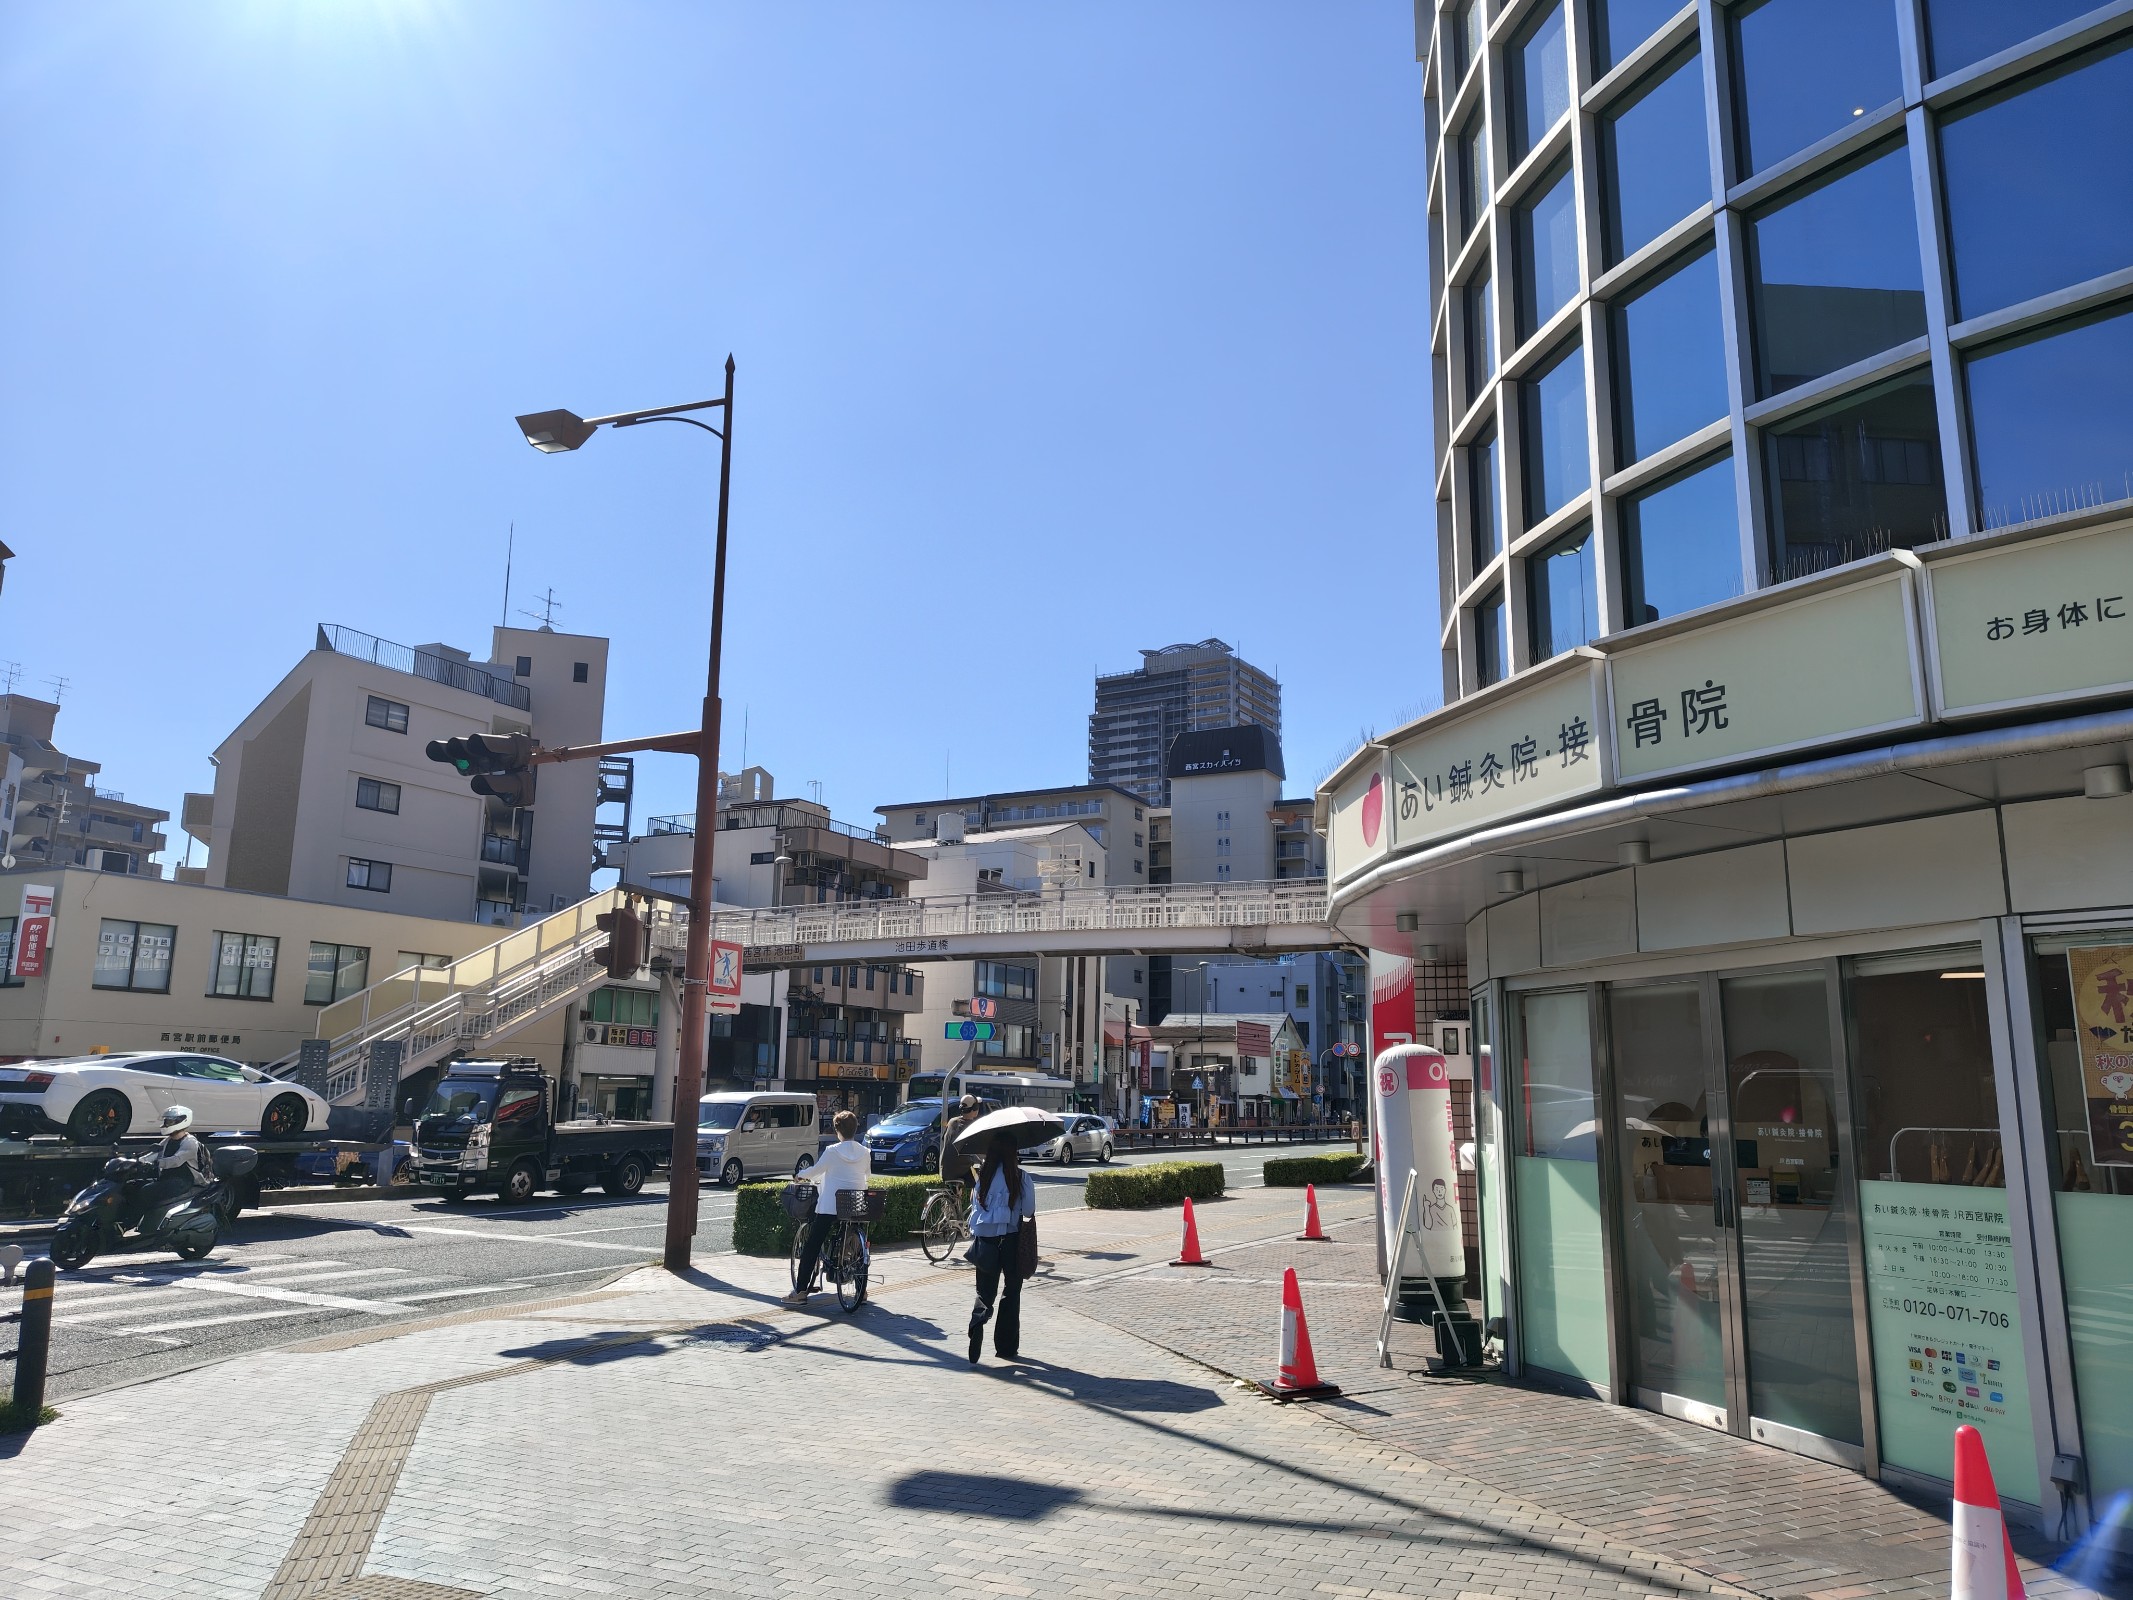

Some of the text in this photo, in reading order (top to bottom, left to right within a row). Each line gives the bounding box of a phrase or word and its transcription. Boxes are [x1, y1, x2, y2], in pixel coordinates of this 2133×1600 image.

[1986, 596, 2126, 641] お身体に
[1185, 759, 1241, 771] 西宮スカイハイツ
[895, 939, 949, 953] 池田歩道橋
[981, 1000, 986, 1012] 2
[963, 1025, 975, 1036] 58
[161, 1032, 241, 1044] 西宮駅前郵便局
[1380, 1072, 1395, 1092] 祝
[1903, 1299, 2010, 1329] 0120-071-706
[1908, 1345, 1922, 1354] VISA
